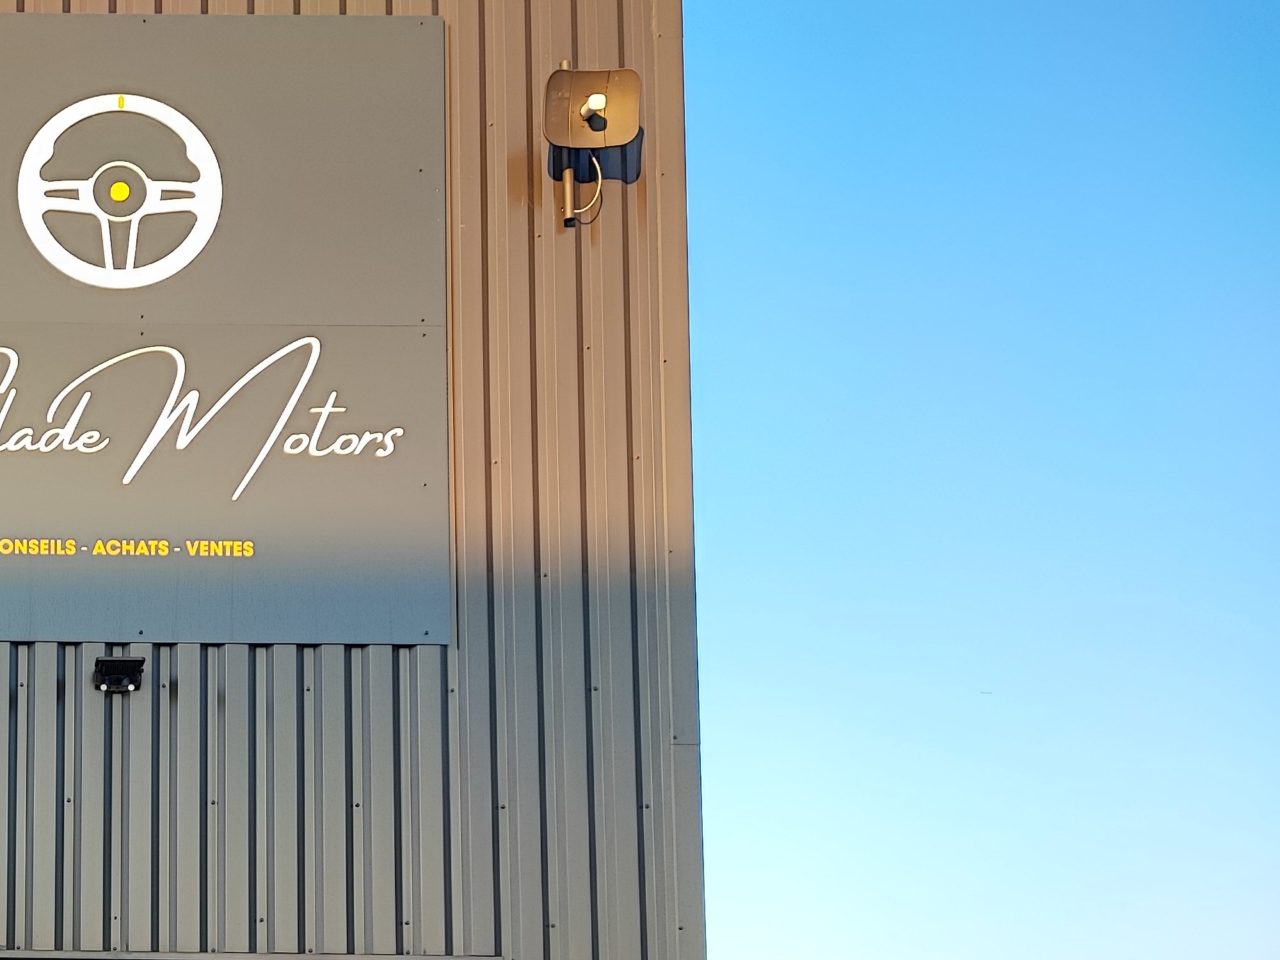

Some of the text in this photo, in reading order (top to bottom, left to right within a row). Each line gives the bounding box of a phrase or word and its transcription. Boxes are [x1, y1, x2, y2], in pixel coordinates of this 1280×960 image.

[46, 335, 405, 502] Motors
[91, 539, 170, 556] ACHATS
[185, 540, 255, 557] VENTES
